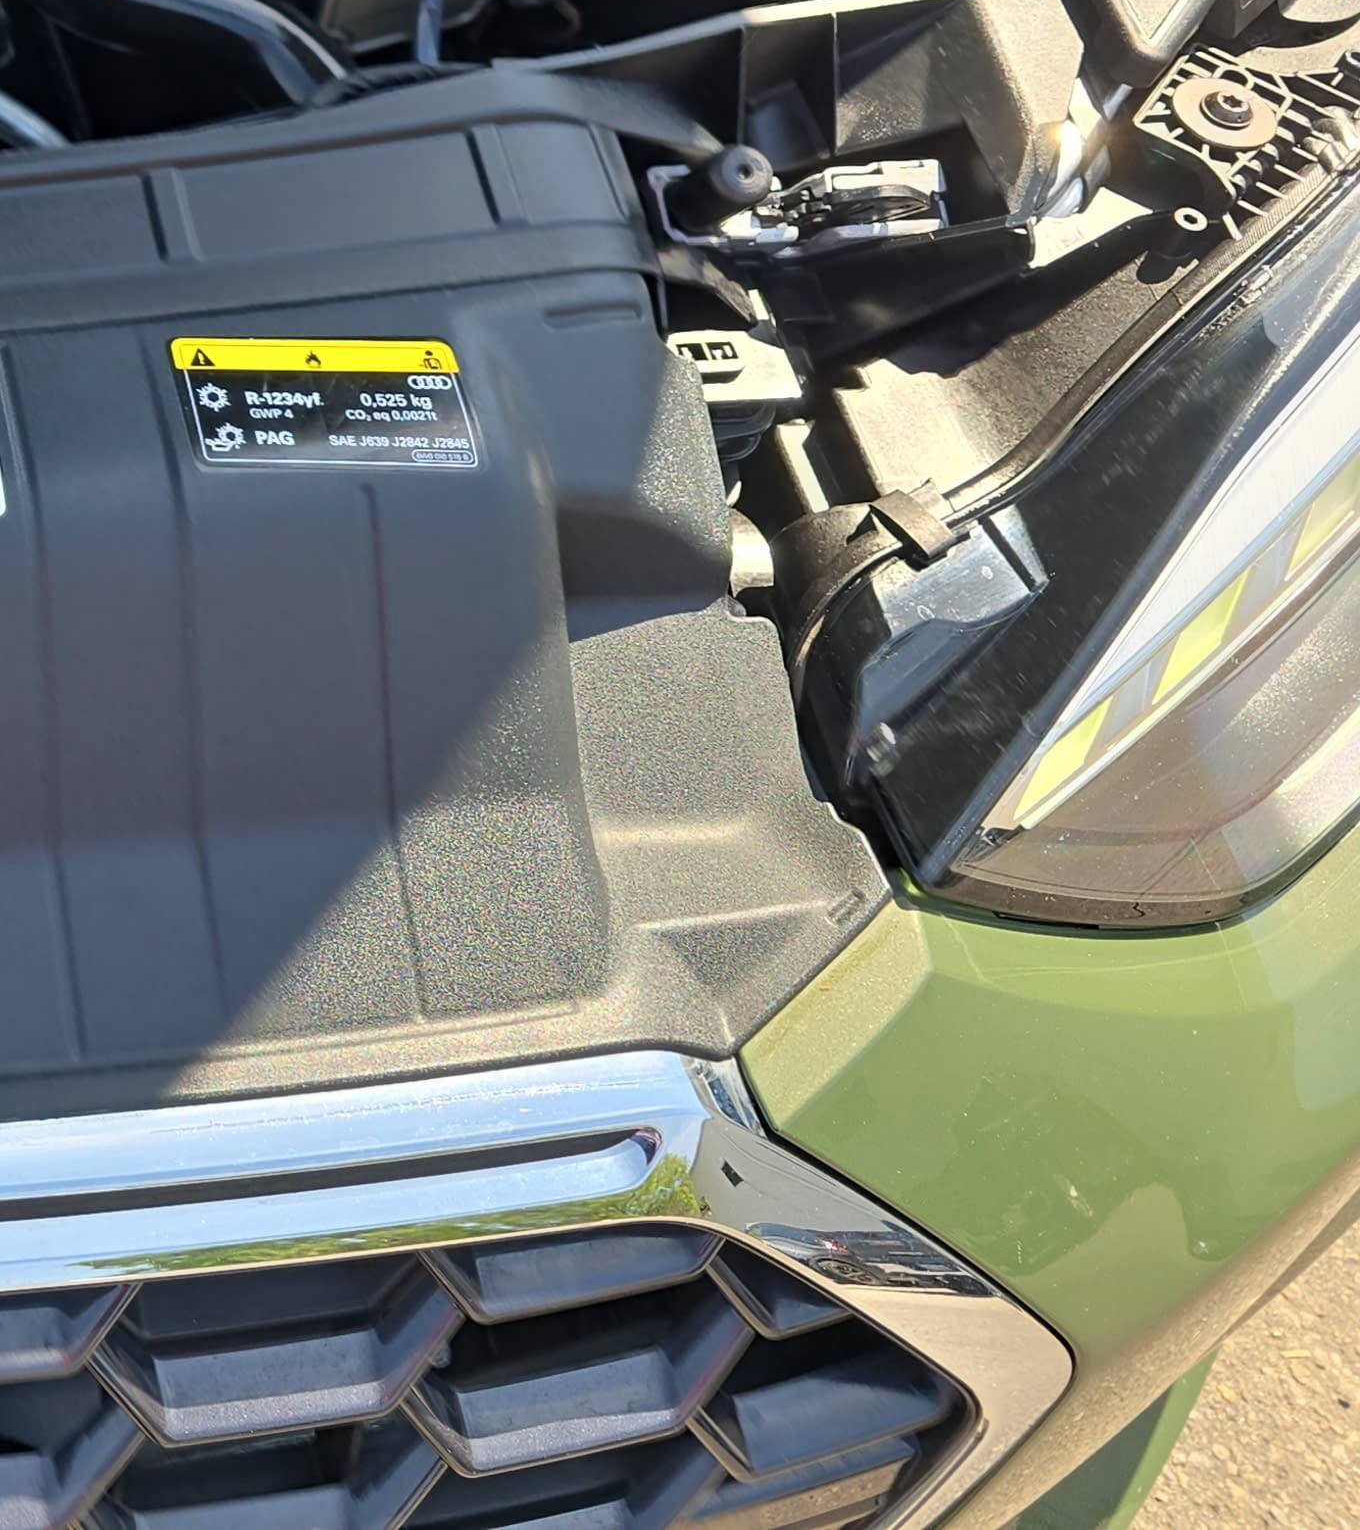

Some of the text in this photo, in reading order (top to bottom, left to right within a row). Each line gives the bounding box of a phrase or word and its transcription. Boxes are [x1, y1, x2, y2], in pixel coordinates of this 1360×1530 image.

[360, 393, 433, 410] 0,525 kg
[249, 408, 294, 419] GWP 4
[373, 412, 391, 422] eq
[255, 430, 295, 445] PAG
[328, 435, 470, 449] SAE J639 J2842 J2845
